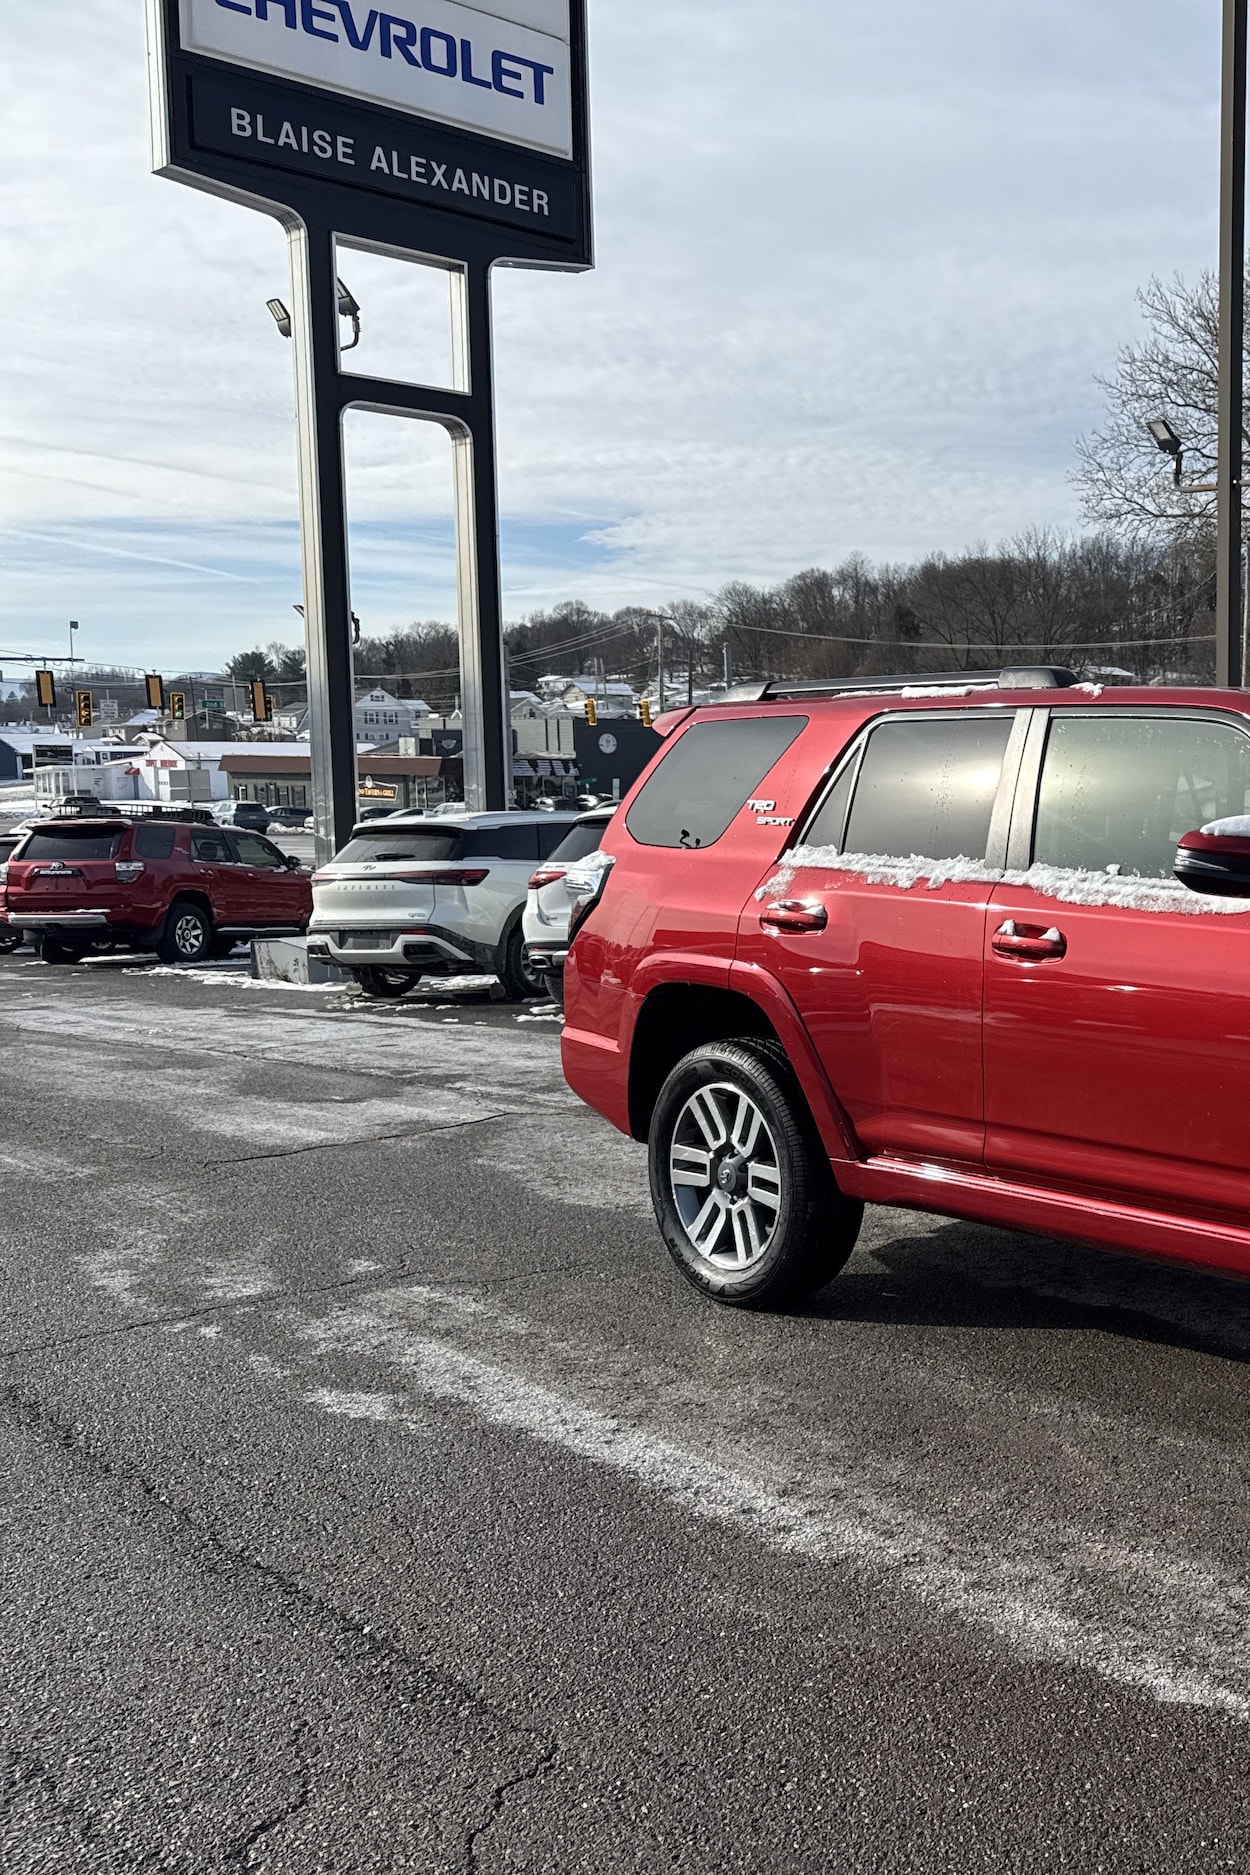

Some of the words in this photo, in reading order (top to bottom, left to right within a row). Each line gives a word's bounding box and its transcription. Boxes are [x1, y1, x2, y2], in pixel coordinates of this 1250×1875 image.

[229, 106, 356, 166] BLAISE
[369, 145, 550, 217] ALEXANDER
[747, 799, 776, 813] TRD
[756, 815, 794, 827] SPORT
